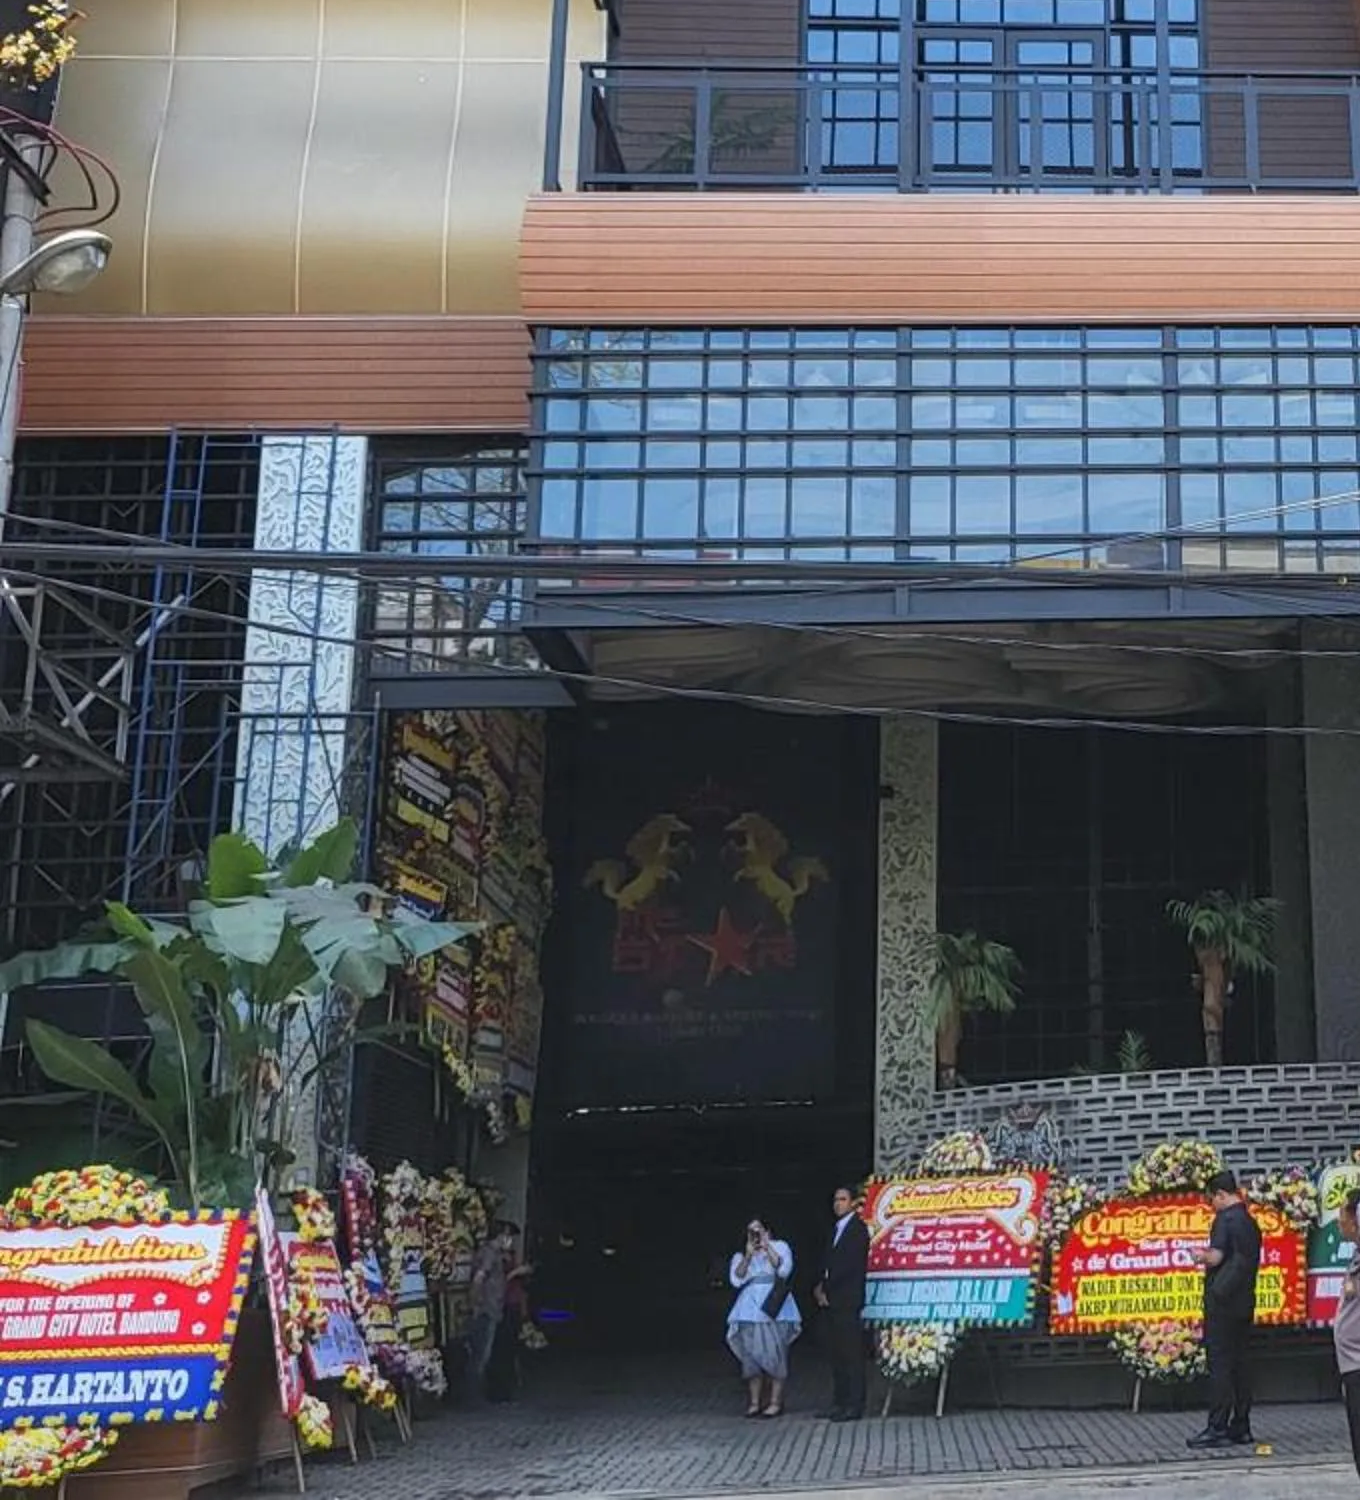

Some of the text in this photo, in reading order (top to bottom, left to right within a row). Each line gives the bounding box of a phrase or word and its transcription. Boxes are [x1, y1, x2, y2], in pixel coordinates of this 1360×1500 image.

[27, 1295, 53, 1311] THE
[55, 1294, 115, 1310] OPENING
[116, 1293, 136, 1309] OF
[2, 1309, 181, 1340] GRAND CITY HOTEL BANDUNG
